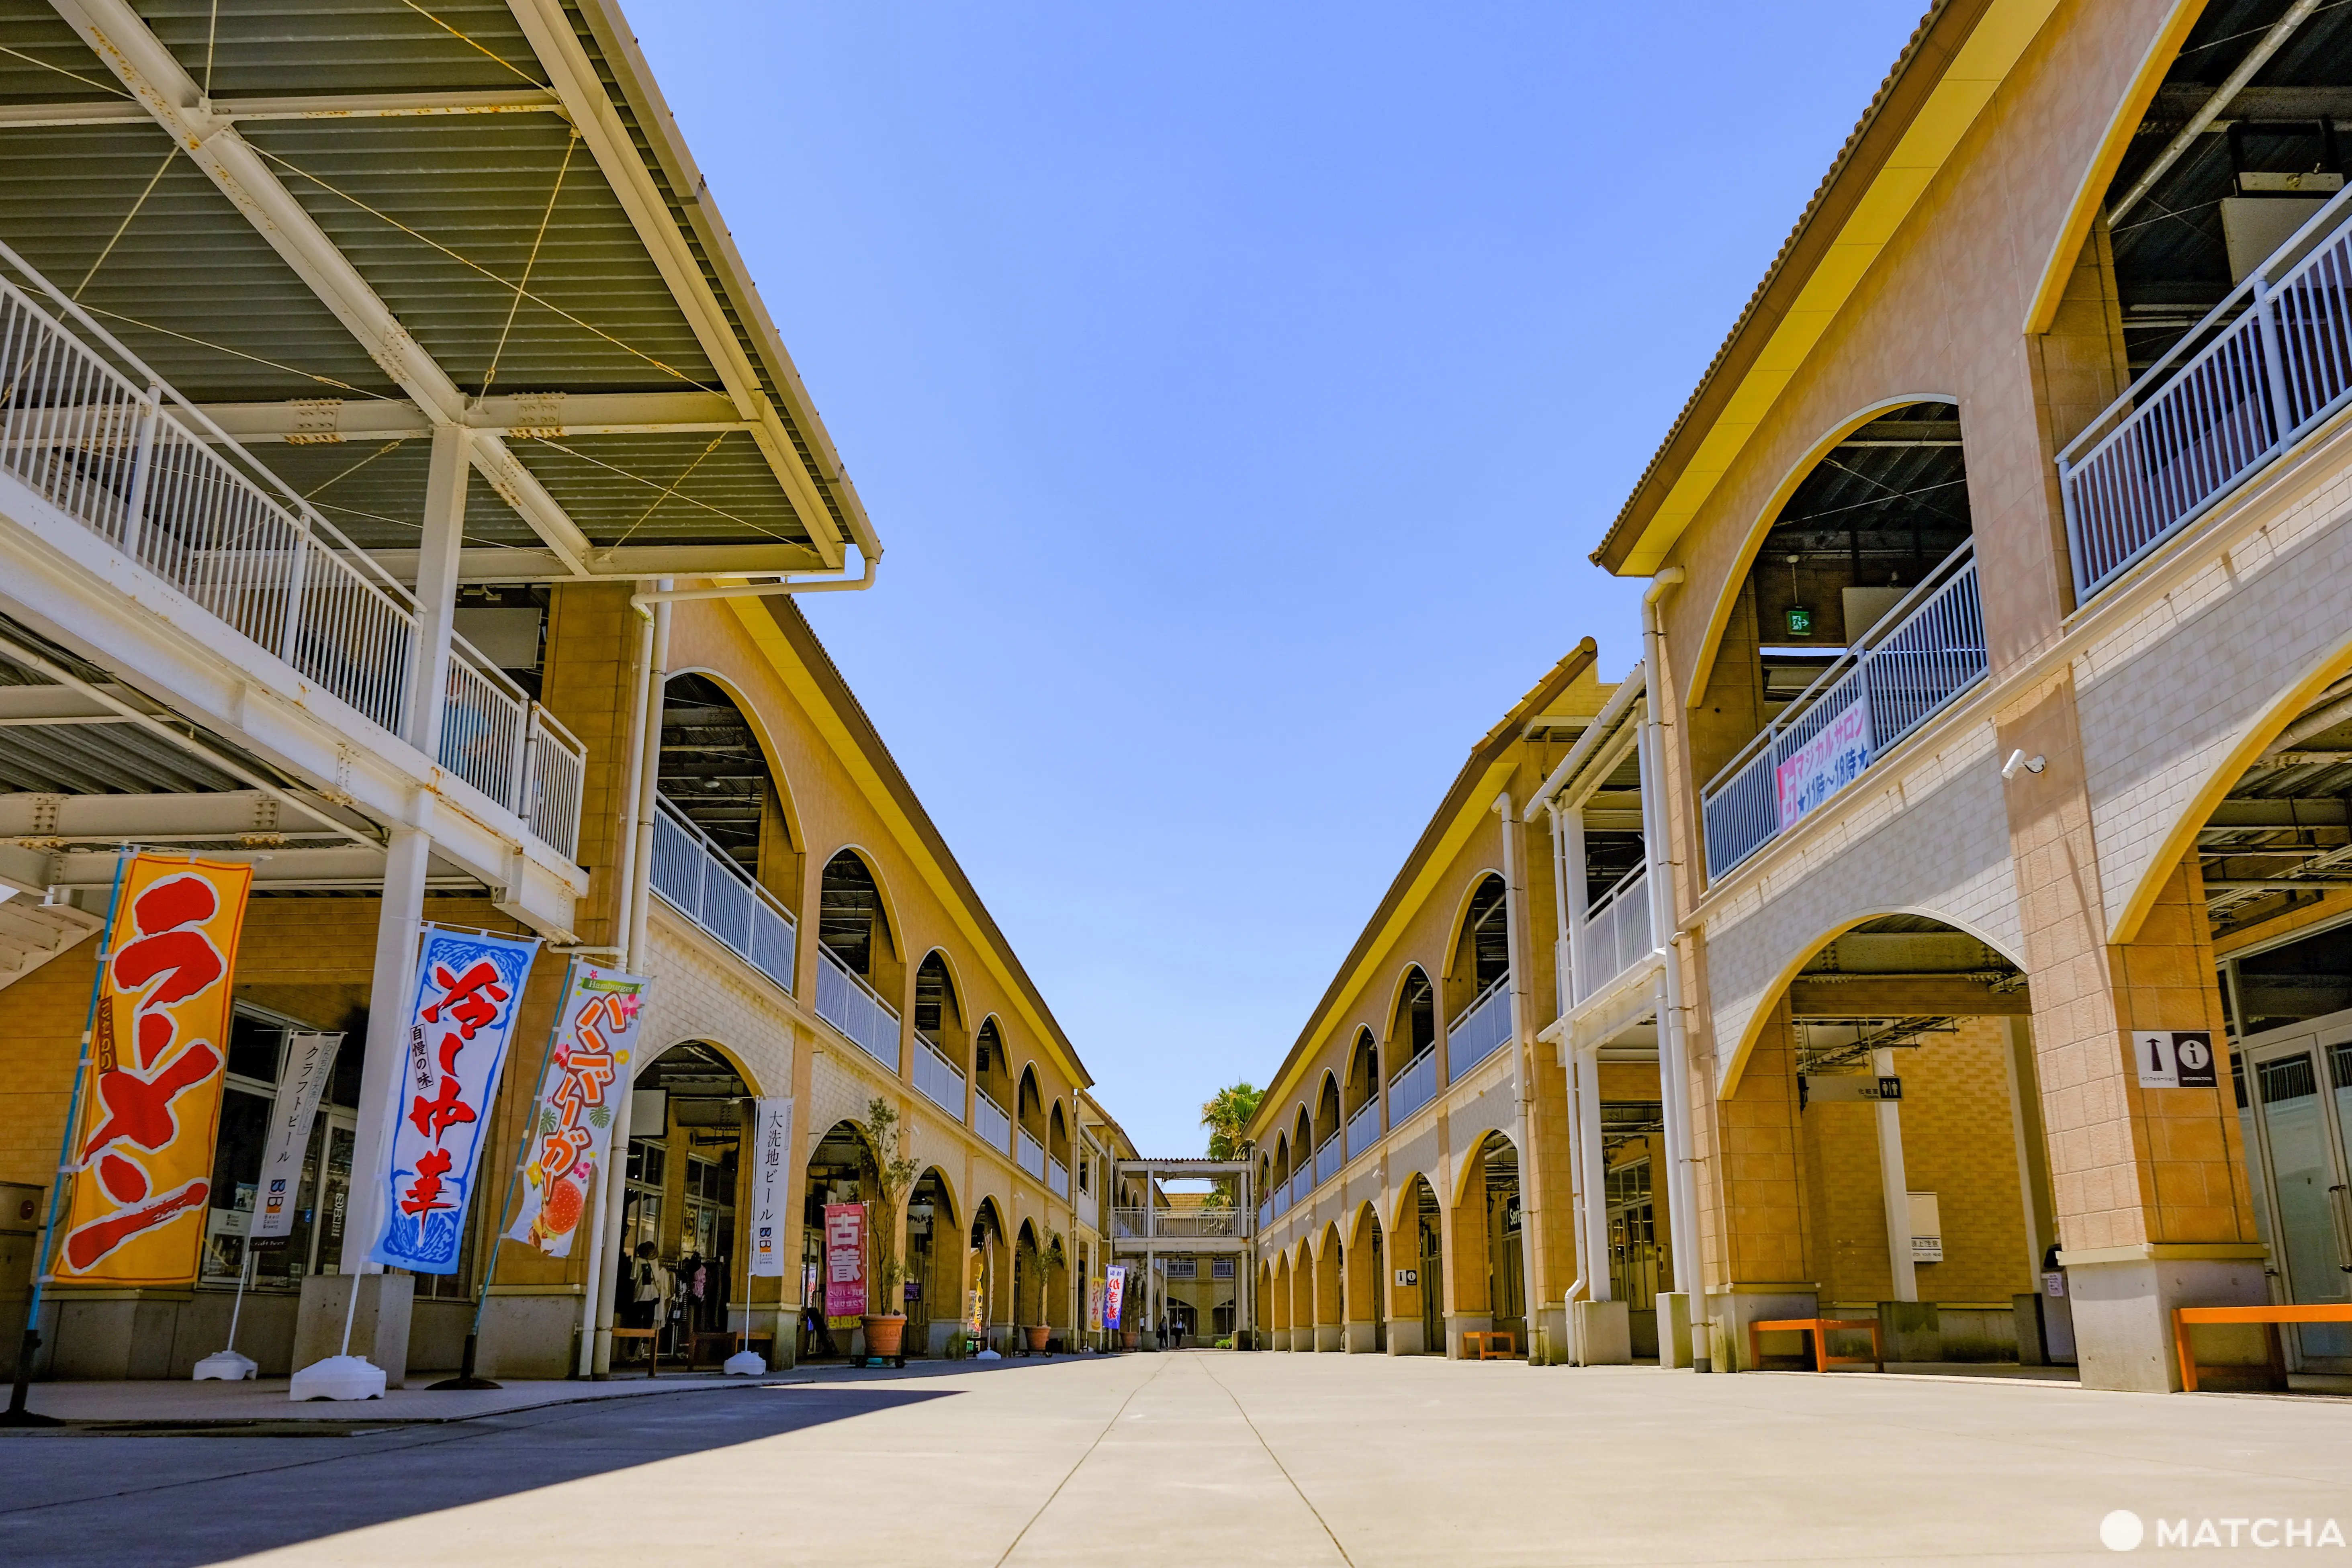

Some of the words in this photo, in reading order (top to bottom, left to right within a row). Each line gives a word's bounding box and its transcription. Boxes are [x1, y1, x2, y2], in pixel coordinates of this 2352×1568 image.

[1796, 708, 1864, 781] マジカルサロン
[588, 980, 634, 993] Hamburger
[64, 874, 226, 1273] ラーメン
[276, 1046, 319, 1163] クラフトビール
[400, 961, 509, 1237] 冷し中華
[413, 1027, 433, 1086] 自慢の味
[759, 1111, 783, 1221] 大洗地ビール
